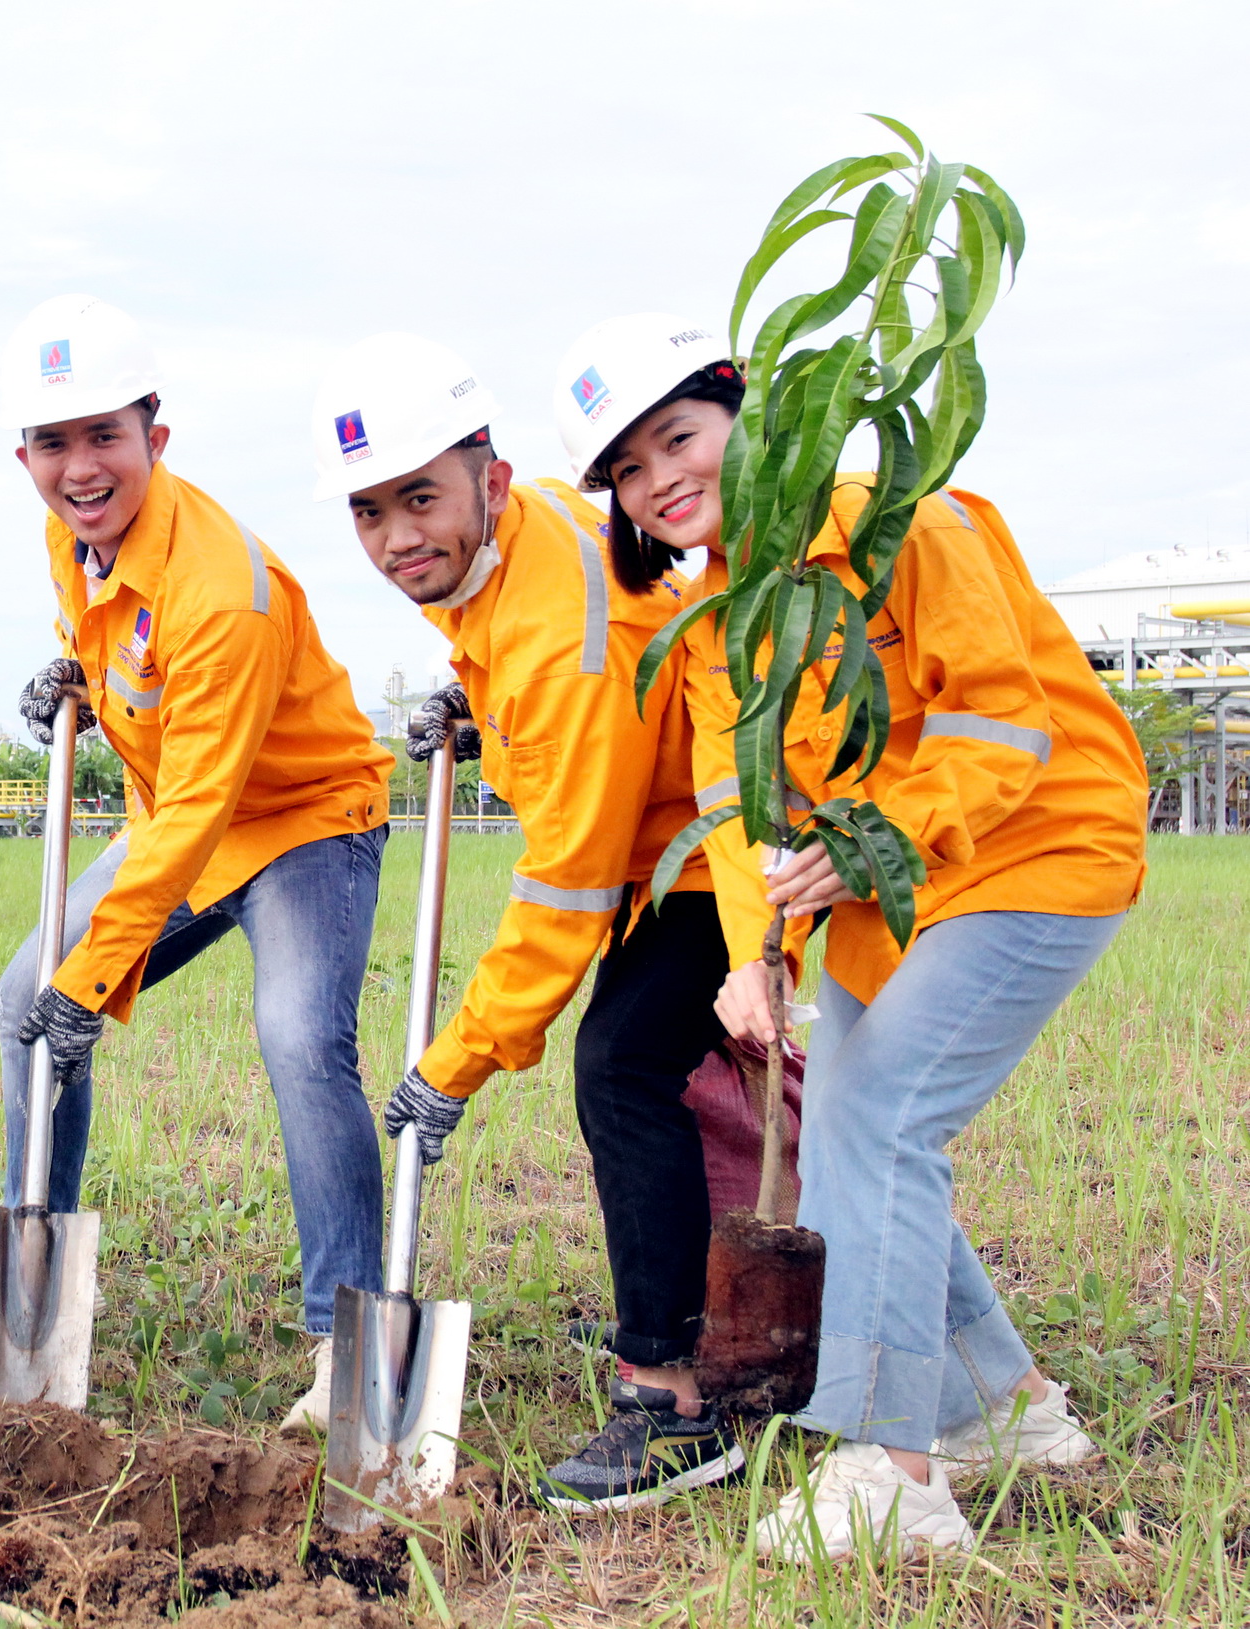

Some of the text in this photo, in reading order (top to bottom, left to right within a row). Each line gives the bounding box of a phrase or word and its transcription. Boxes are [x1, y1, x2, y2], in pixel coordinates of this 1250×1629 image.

[48, 374, 67, 384] GAS
[591, 396, 613, 420] GAS
[345, 447, 370, 462] PV GAS
